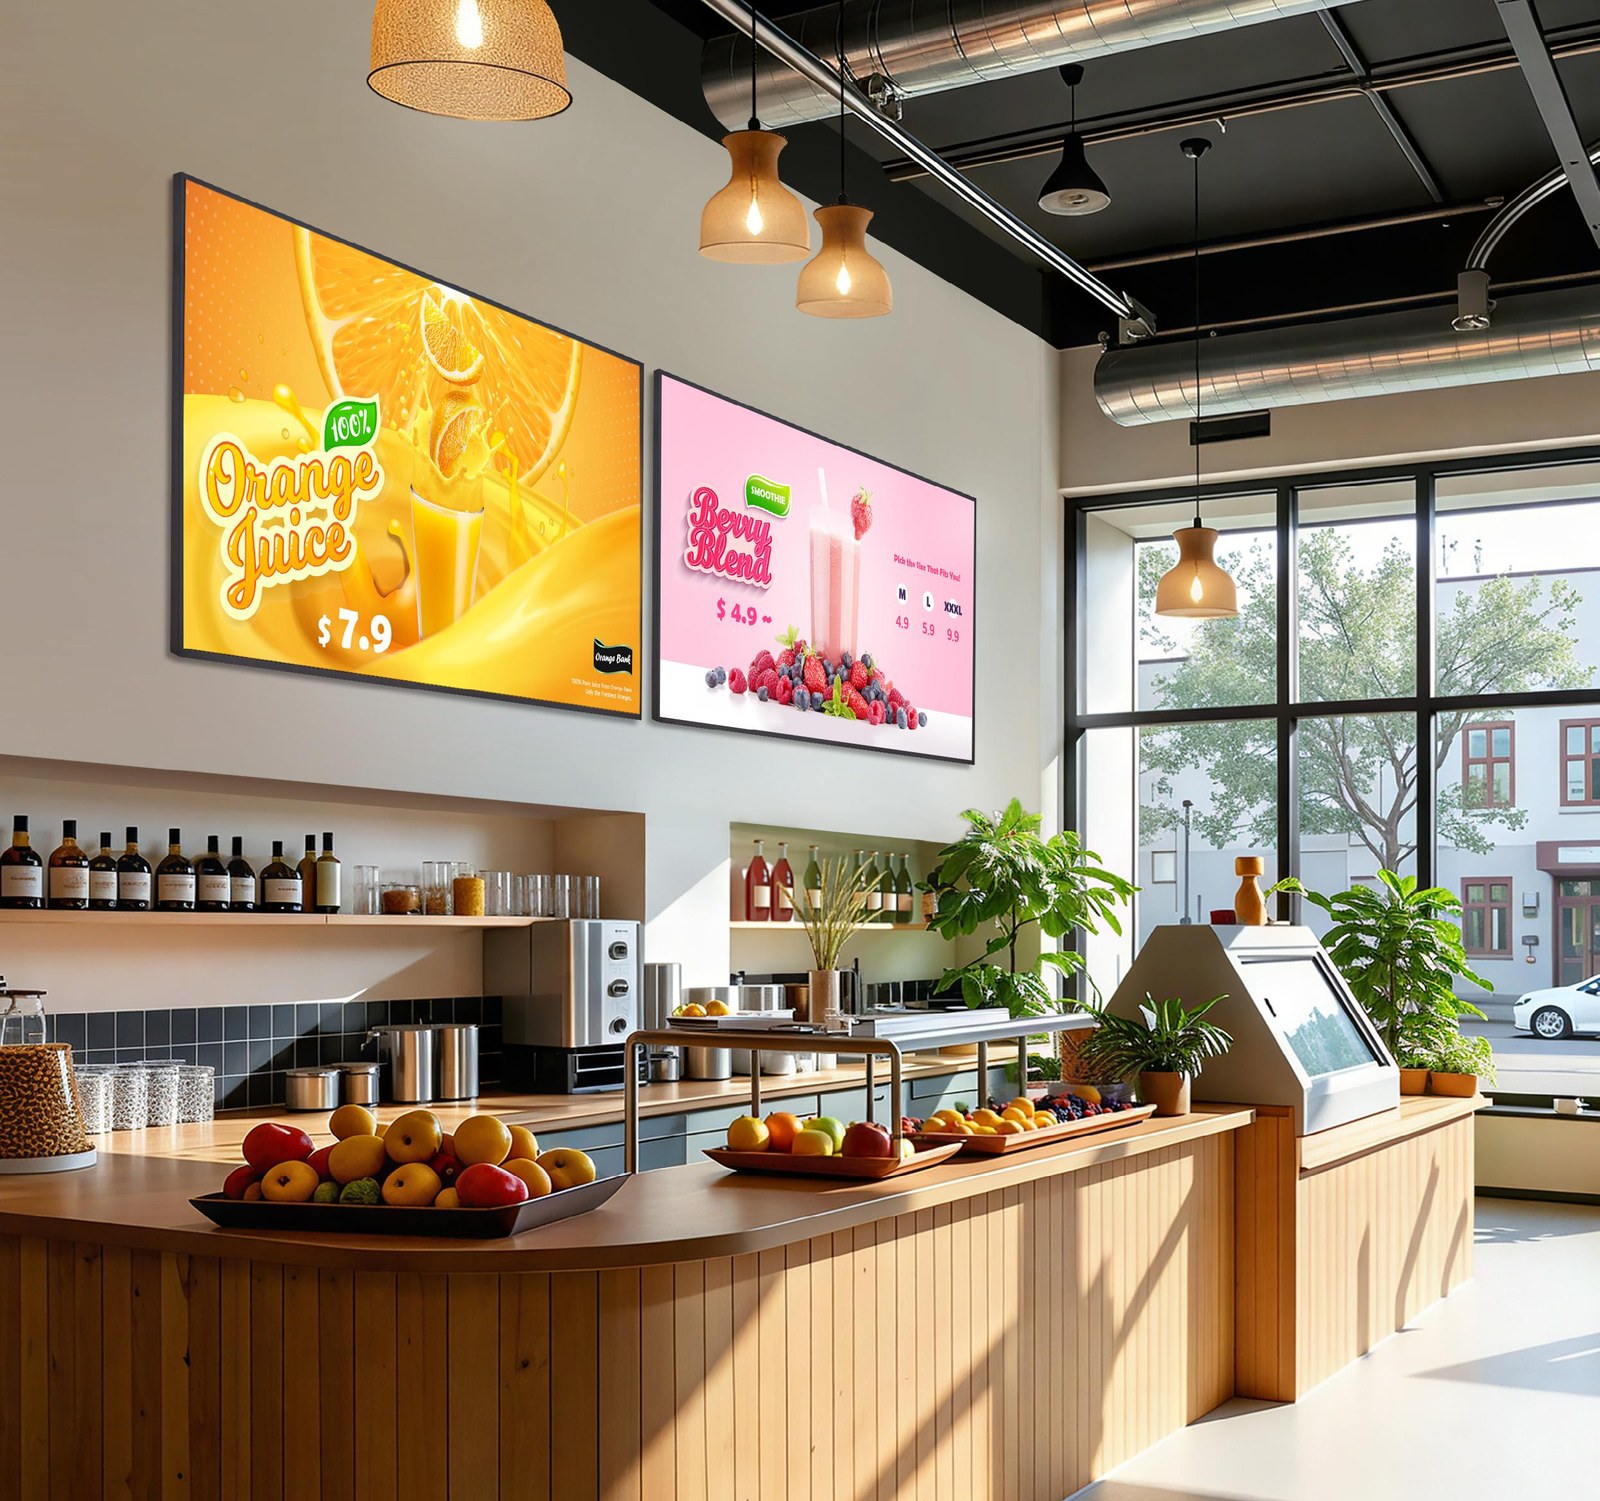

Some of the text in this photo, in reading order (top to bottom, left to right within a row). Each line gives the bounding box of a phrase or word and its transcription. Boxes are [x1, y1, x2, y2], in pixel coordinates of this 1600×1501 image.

[331, 408, 371, 443] 100%
[206, 441, 380, 521] Orange
[750, 485, 787, 506] SMOOTHIE
[689, 486, 773, 558] Berry
[227, 506, 351, 610] Juice
[686, 527, 772, 585] Blend
[927, 564, 939, 576] That
[731, 603, 758, 626] 4.9
[898, 588, 963, 616] M L XXXL
[338, 607, 392, 654] 7.9
[895, 615, 960, 643] 4.9 5.9 9.9
[595, 652, 631, 665] Orange Bank
